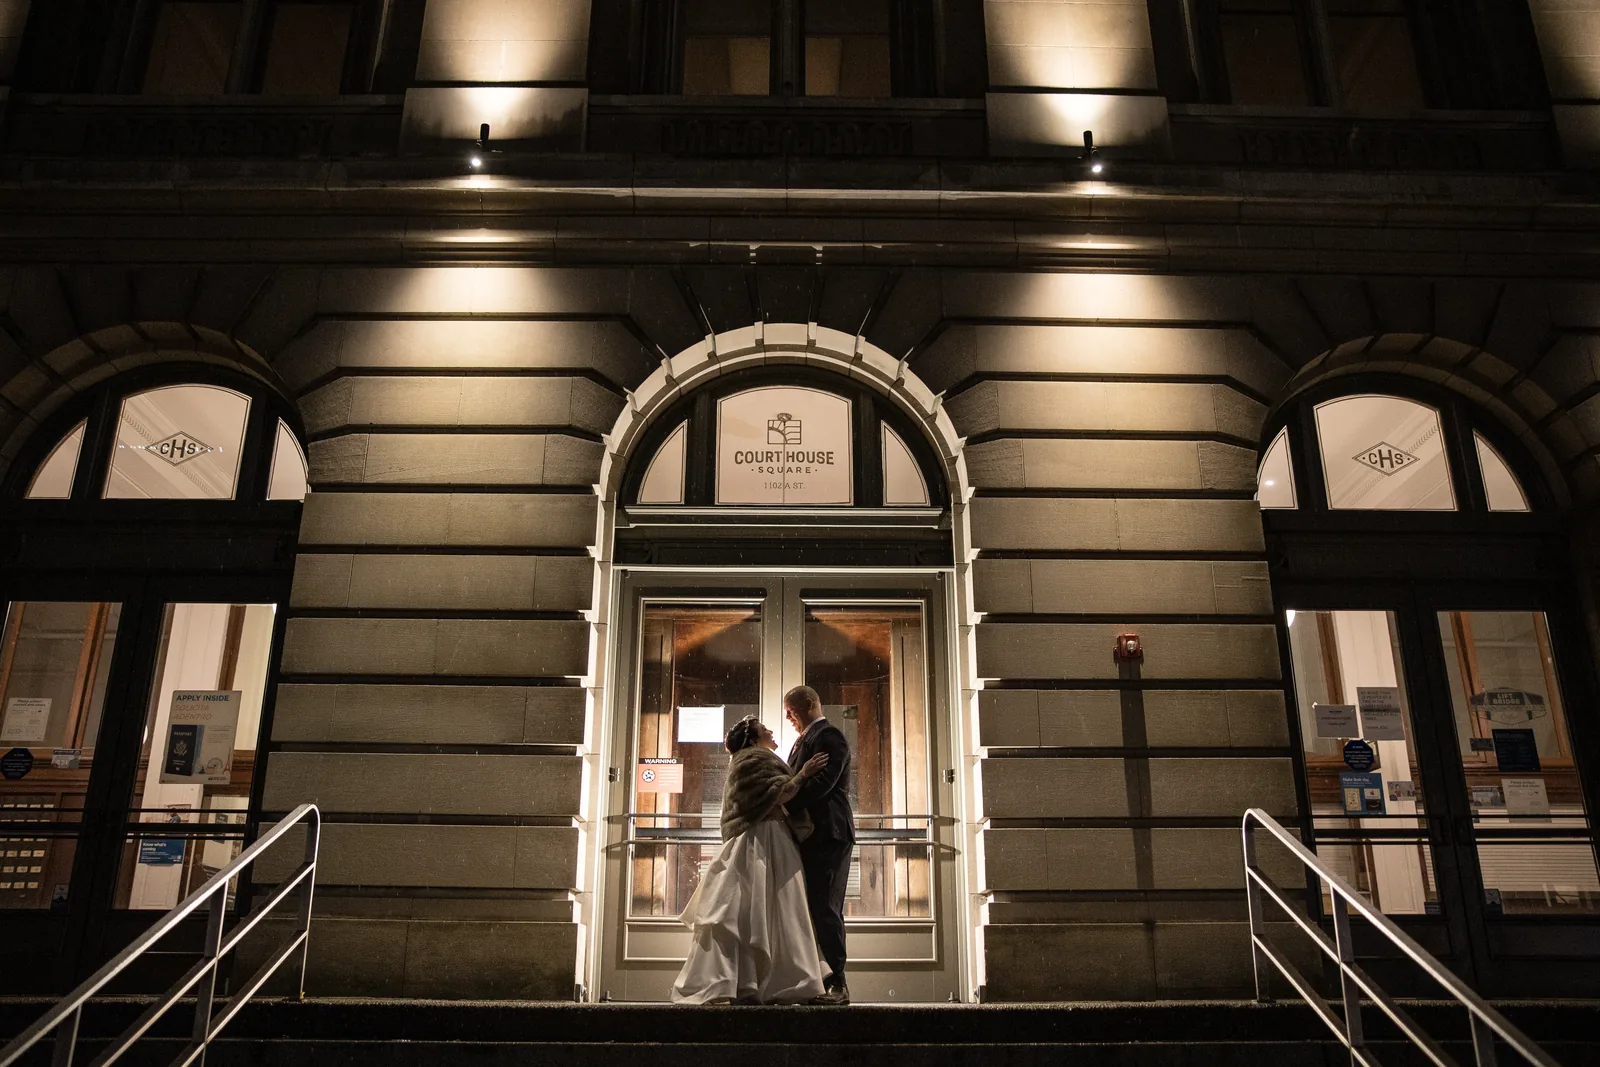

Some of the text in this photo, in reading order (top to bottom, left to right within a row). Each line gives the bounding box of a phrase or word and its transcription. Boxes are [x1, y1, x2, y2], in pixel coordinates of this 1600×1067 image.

[160, 439, 196, 458] CHS
[1368, 449, 1404, 468] CHS
[758, 466, 812, 474] SQUARE
